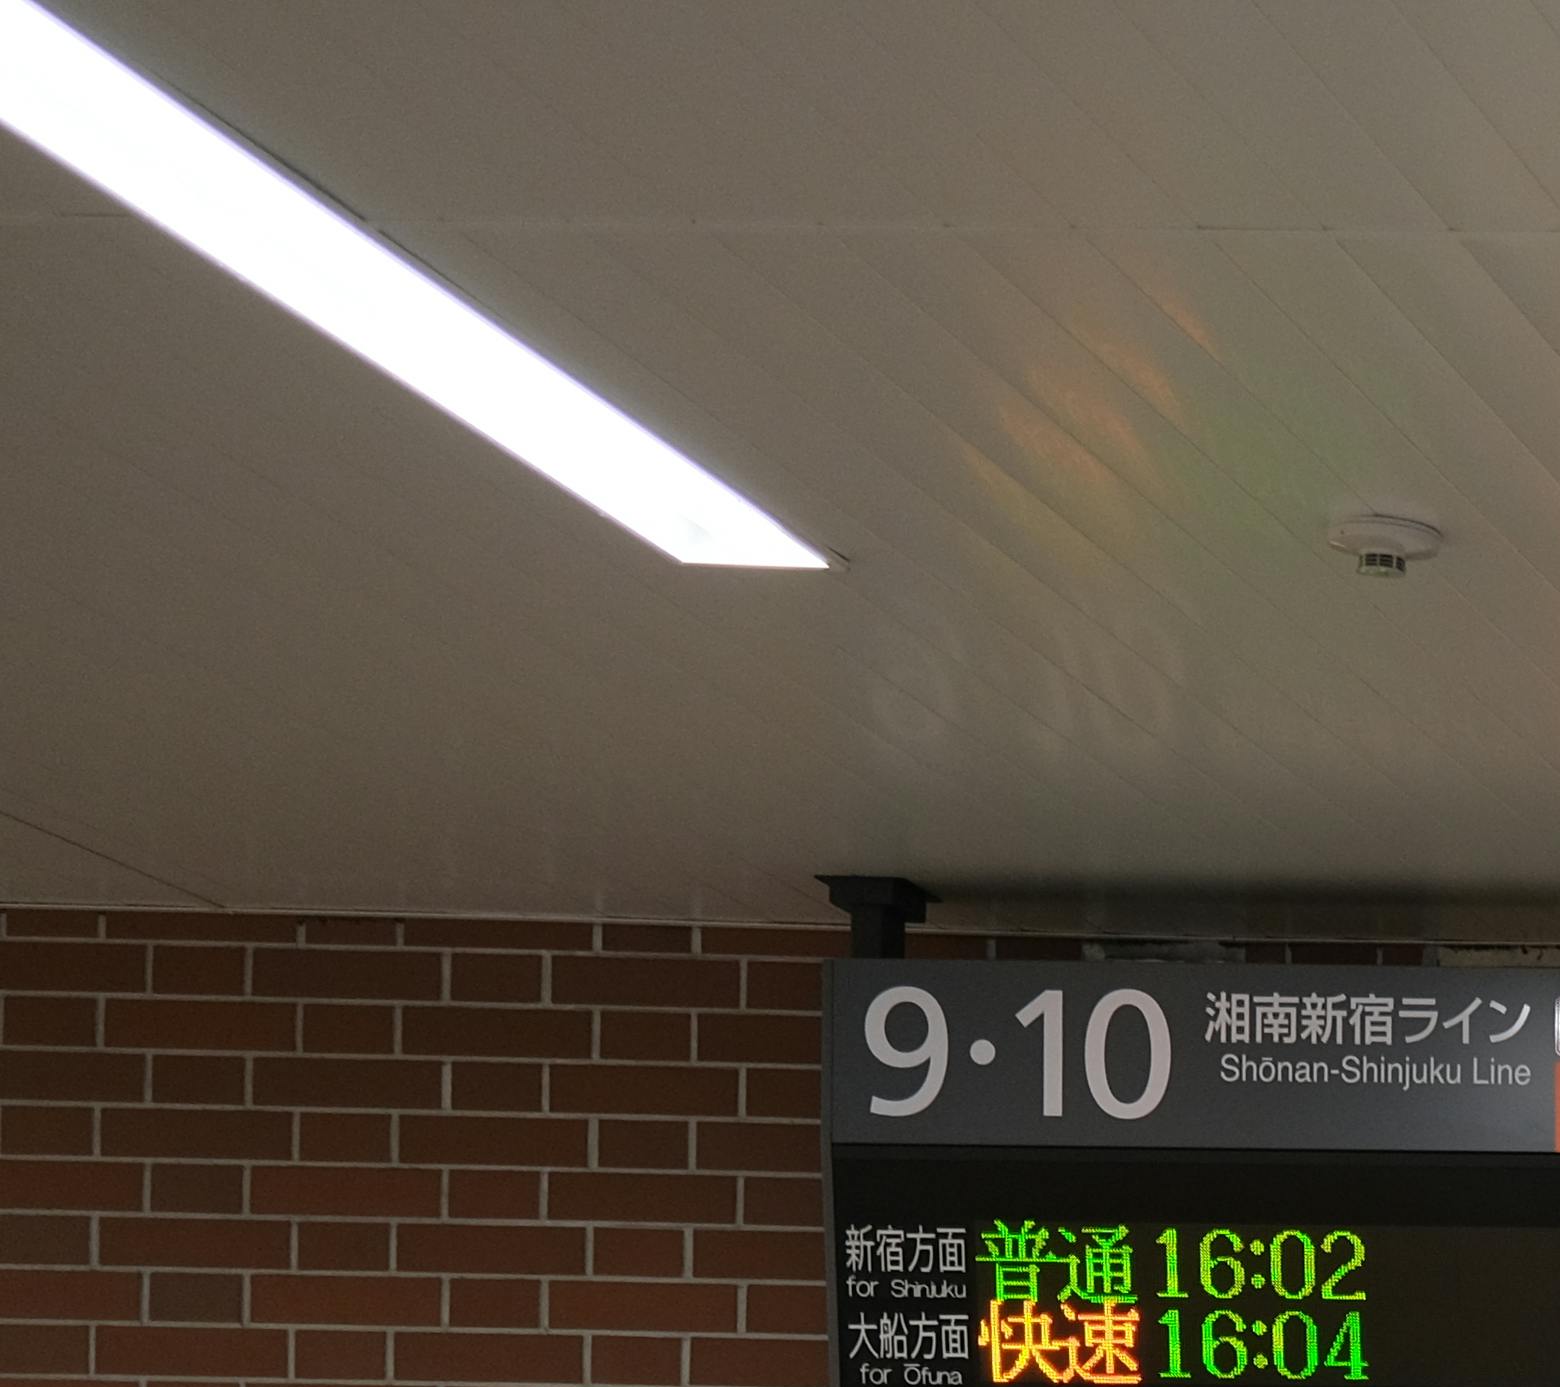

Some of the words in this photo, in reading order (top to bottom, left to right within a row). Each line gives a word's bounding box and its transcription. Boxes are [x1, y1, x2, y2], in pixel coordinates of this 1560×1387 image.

[1205, 992, 1531, 1045] 湘南新宿ライン
[1220, 1053, 1461, 1091] Shōnan-Shinjuku
[1473, 1056, 1532, 1086] Line
[845, 1225, 967, 1273] 新宿方面
[975, 1219, 1138, 1304] 普通
[1155, 1229, 1367, 1302] 16:02
[847, 1276, 884, 1299] for
[891, 1277, 967, 1300] Shinjuku
[848, 1313, 969, 1360] 大船方面
[978, 1299, 1143, 1385] 快速
[1159, 1309, 1369, 1381] 16:04
[861, 1364, 895, 1384] for
